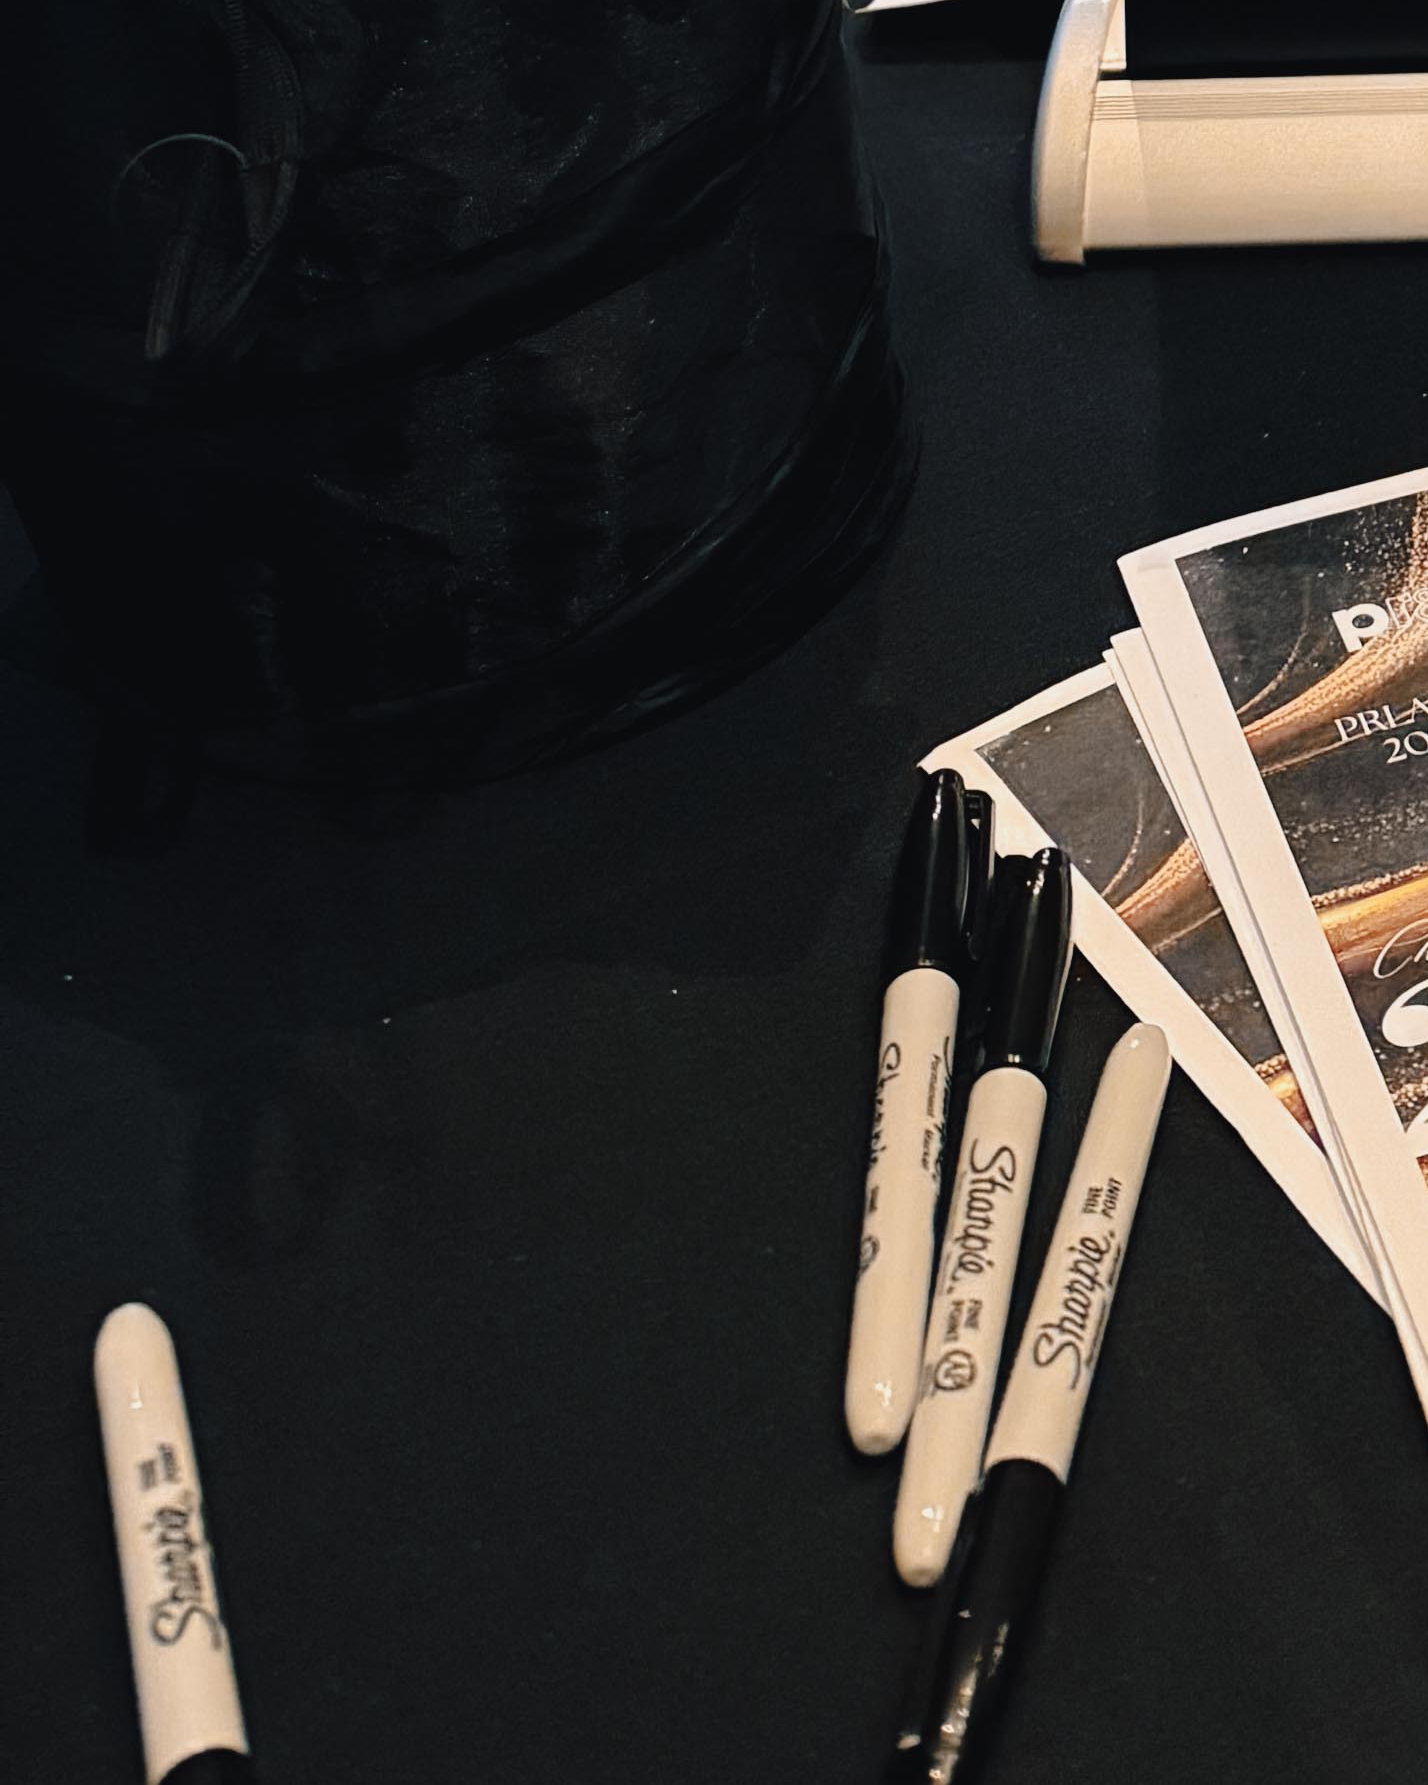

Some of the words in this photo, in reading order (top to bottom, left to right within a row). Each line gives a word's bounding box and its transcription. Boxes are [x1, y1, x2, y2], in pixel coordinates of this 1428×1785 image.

[951, 1137, 1018, 1283] Sharpie
[1100, 1177, 1123, 1220] POINT
[1033, 1234, 1114, 1392] Sharpie
